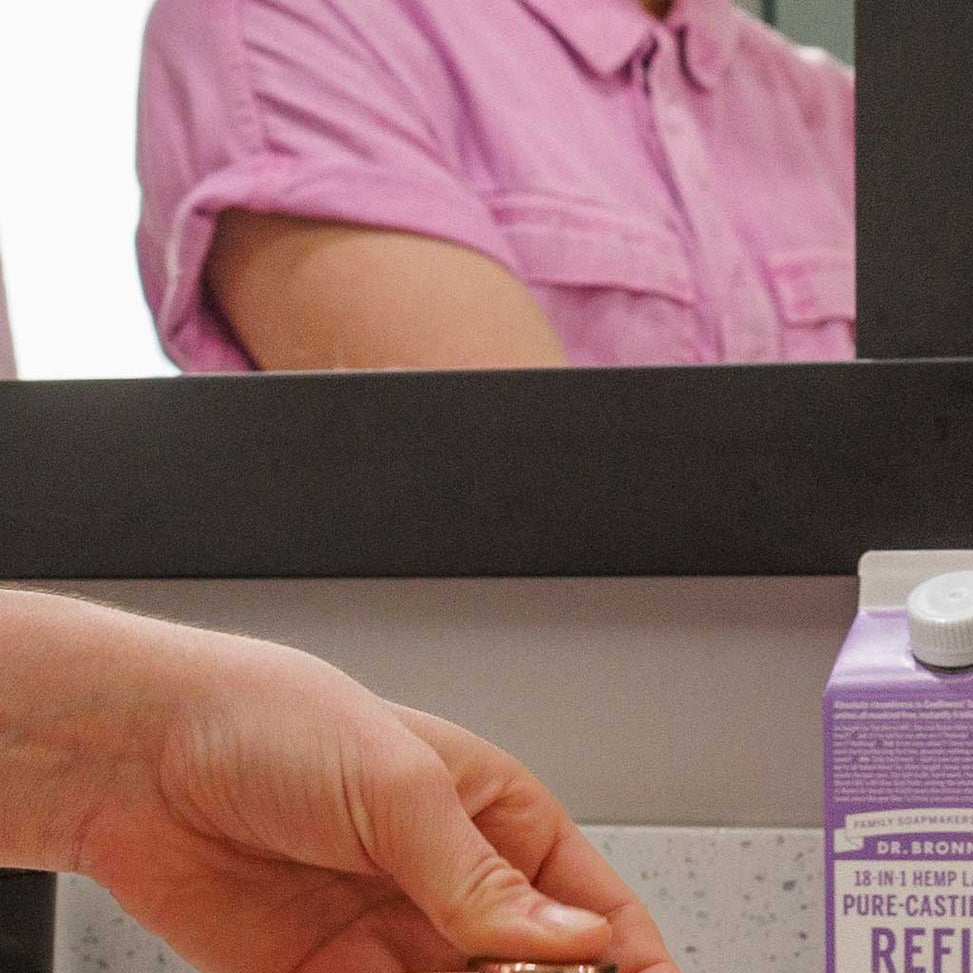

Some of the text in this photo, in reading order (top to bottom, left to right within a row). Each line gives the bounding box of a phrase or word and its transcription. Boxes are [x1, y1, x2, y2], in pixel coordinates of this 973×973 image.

[853, 818, 893, 829] FAMILY
[854, 871, 907, 887] 18-IN-1
[912, 871, 957, 887] HEMP
